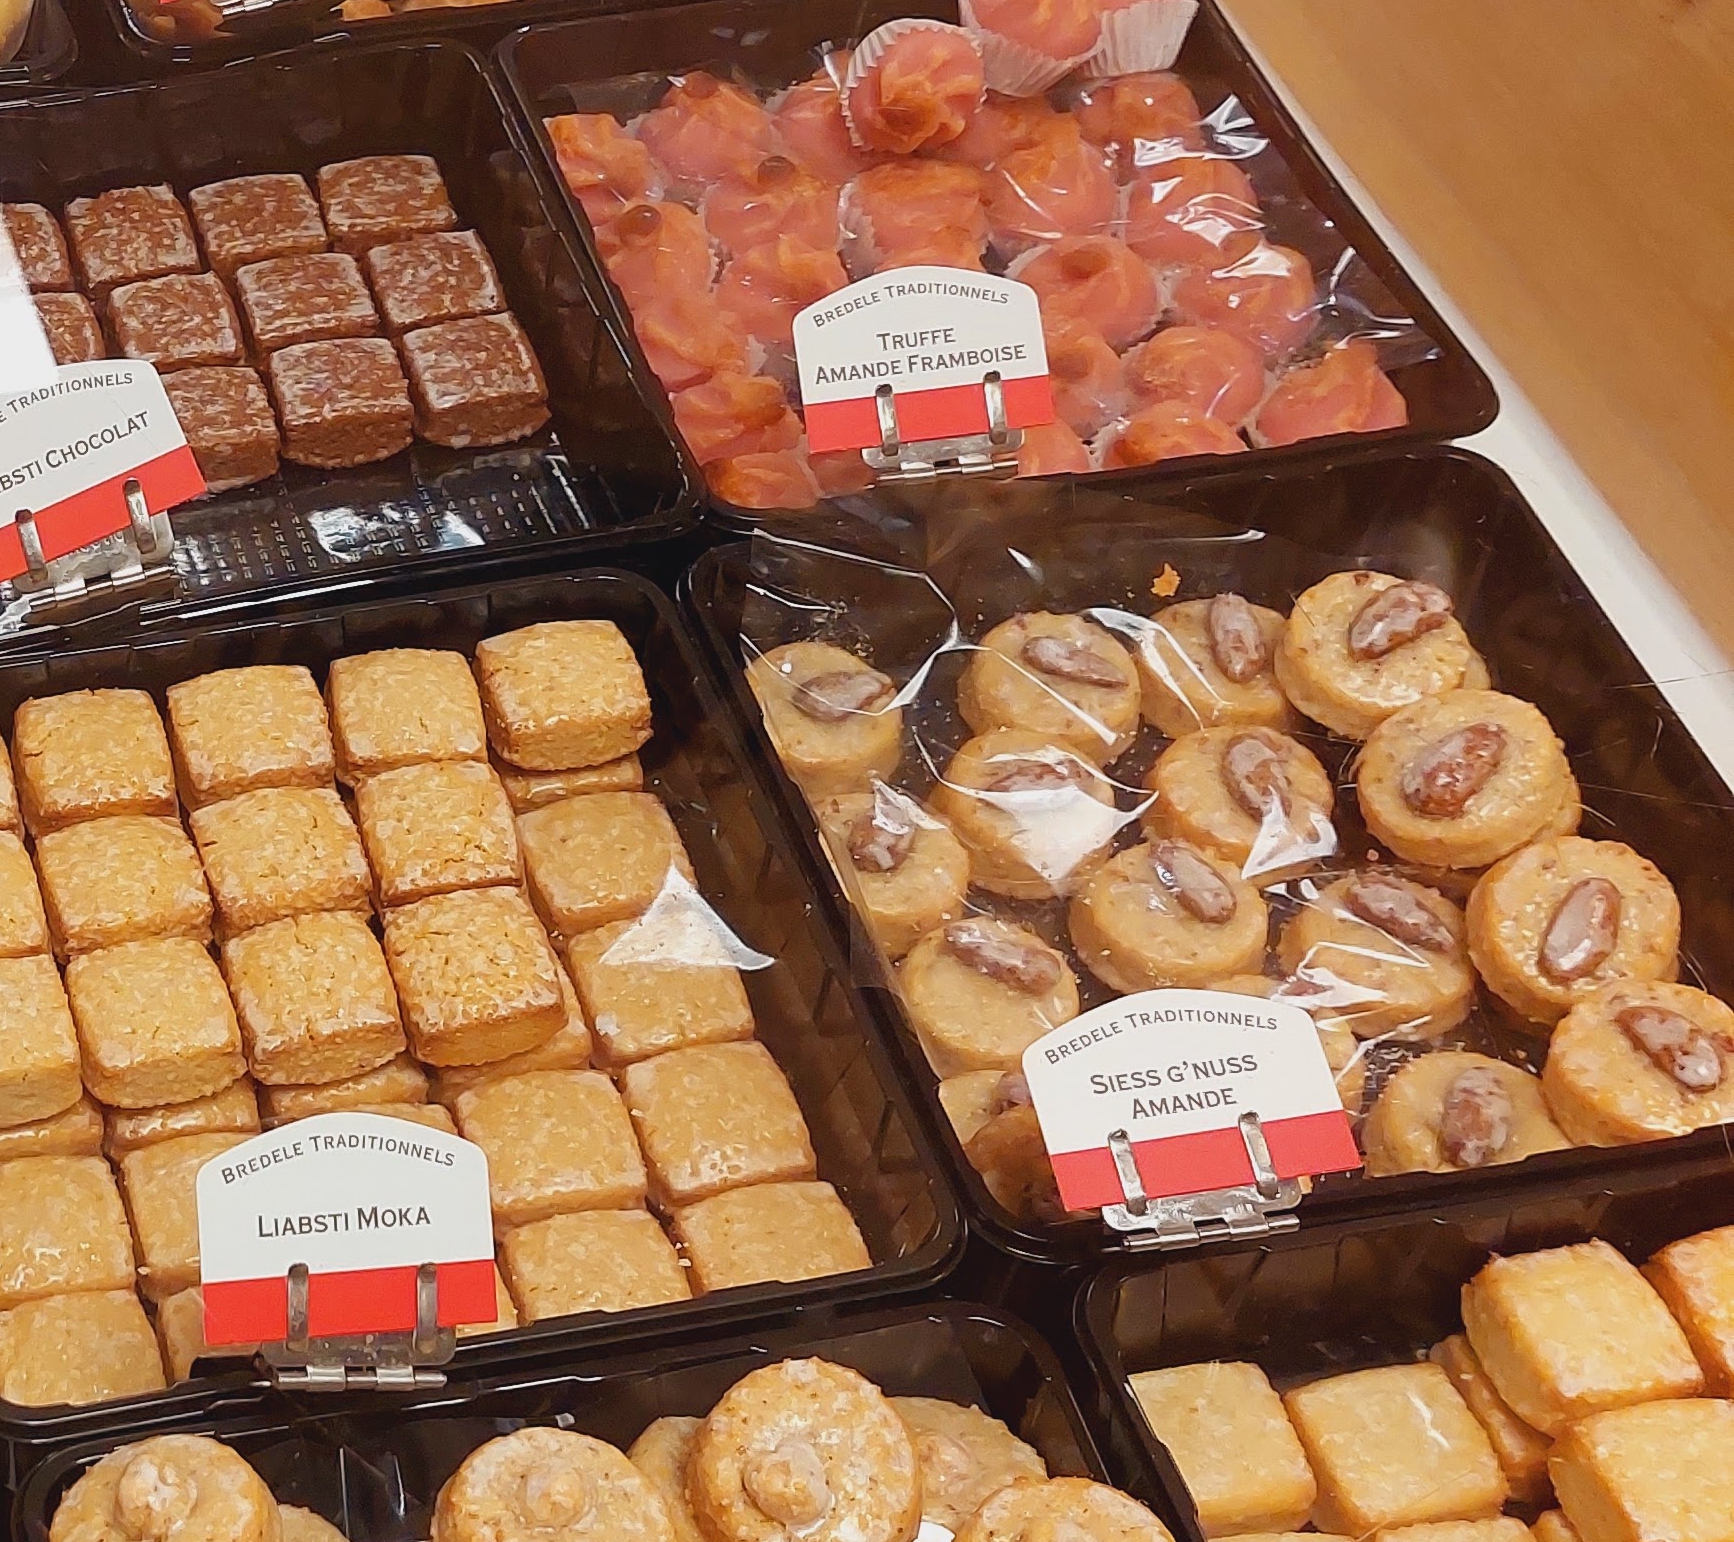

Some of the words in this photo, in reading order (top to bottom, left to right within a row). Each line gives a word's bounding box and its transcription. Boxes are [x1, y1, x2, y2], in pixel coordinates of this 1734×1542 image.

[812, 291, 881, 328] BREDELE
[884, 282, 1009, 304] TRADITIONNELS
[876, 327, 956, 352] TRUFFE
[815, 359, 903, 385] AMANDE
[907, 343, 1027, 374] FRAMBOISE
[6, 372, 133, 414] TRADITIONNELS
[45, 410, 150, 470] CHOCOLAT
[1044, 1021, 1124, 1065] BREDELE
[1124, 1009, 1278, 1031] TRADITIONNELS
[1090, 1069, 1162, 1095] SIESS
[1166, 1054, 1258, 1083] G'NUSS
[1132, 1087, 1238, 1120] AMANDE
[221, 1141, 304, 1185] BREDELE
[309, 1134, 455, 1167] TRADITIONNELS
[257, 1212, 349, 1238] LIABSTI
[356, 1206, 431, 1230] MOKA
